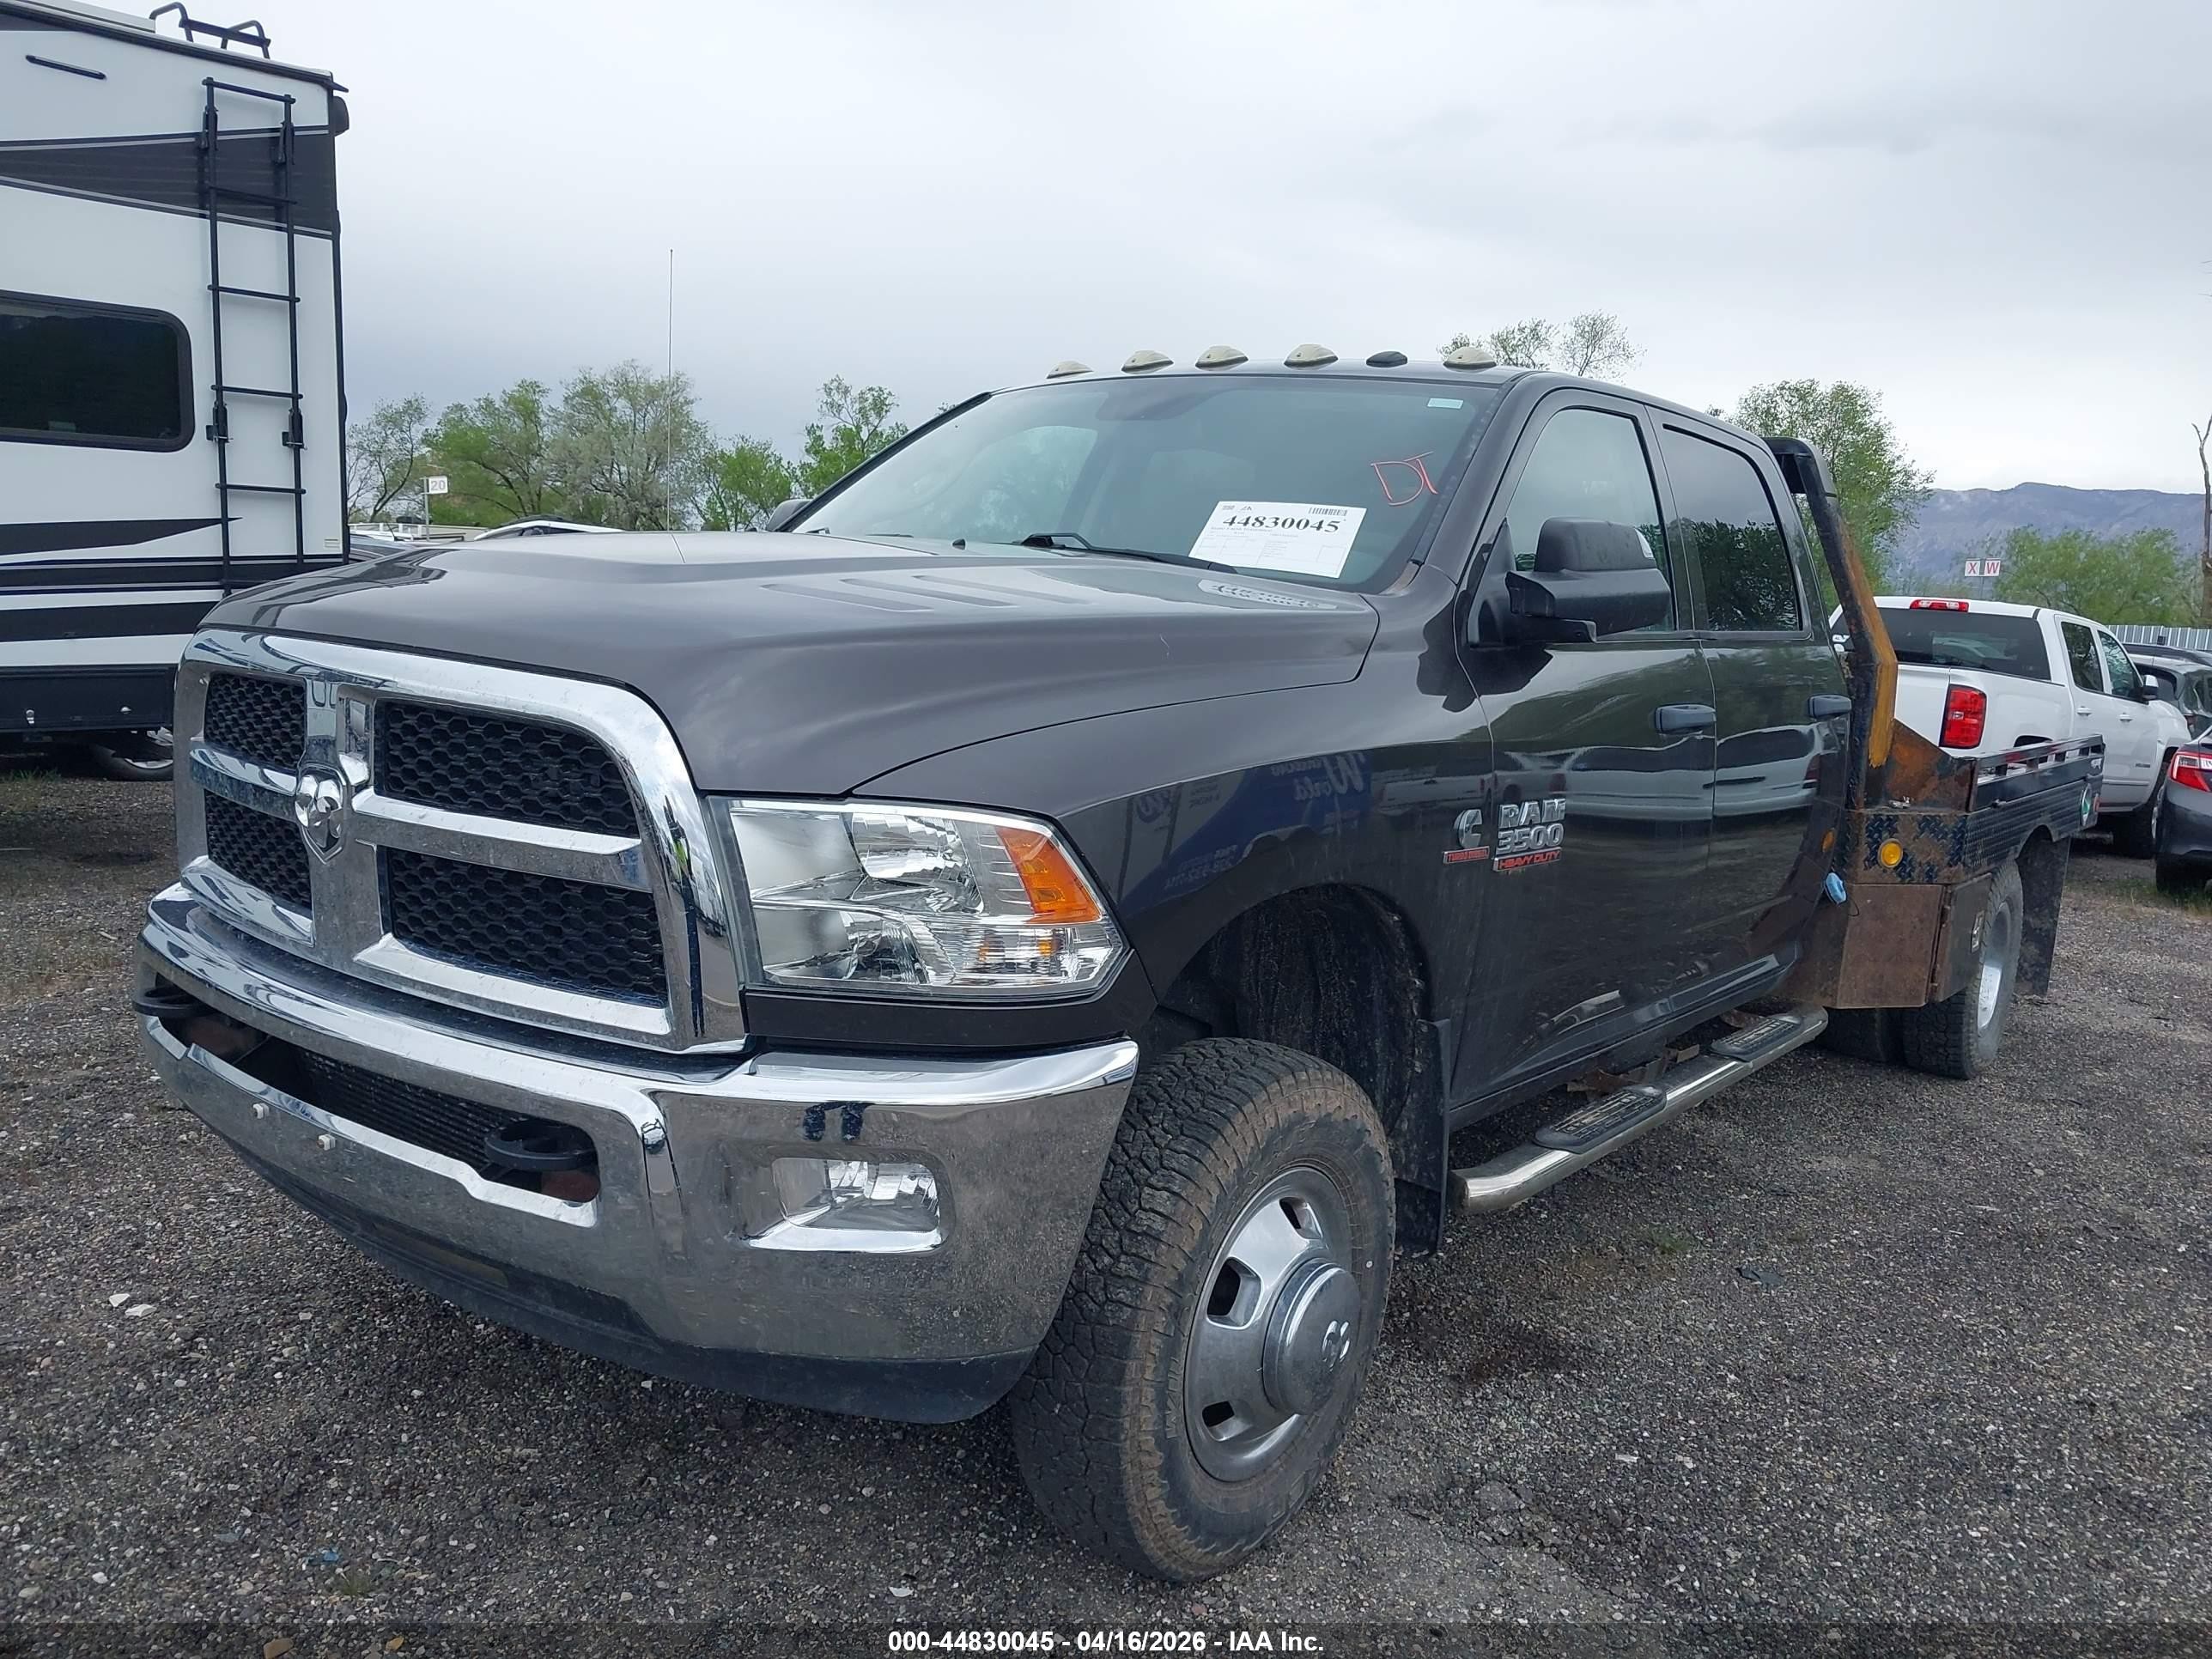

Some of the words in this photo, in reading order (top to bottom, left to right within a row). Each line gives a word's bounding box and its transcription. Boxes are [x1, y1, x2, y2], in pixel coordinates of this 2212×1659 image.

[431, 481, 446, 491] 20
[1222, 514, 1341, 533] 44830045
[1967, 562, 1978, 574] X
[1986, 562, 1999, 574] W
[1499, 798, 1566, 828] RAM
[1497, 823, 1565, 854] 3500
[1500, 854, 1534, 869] HEAVY
[1534, 850, 1561, 864] DUTY
